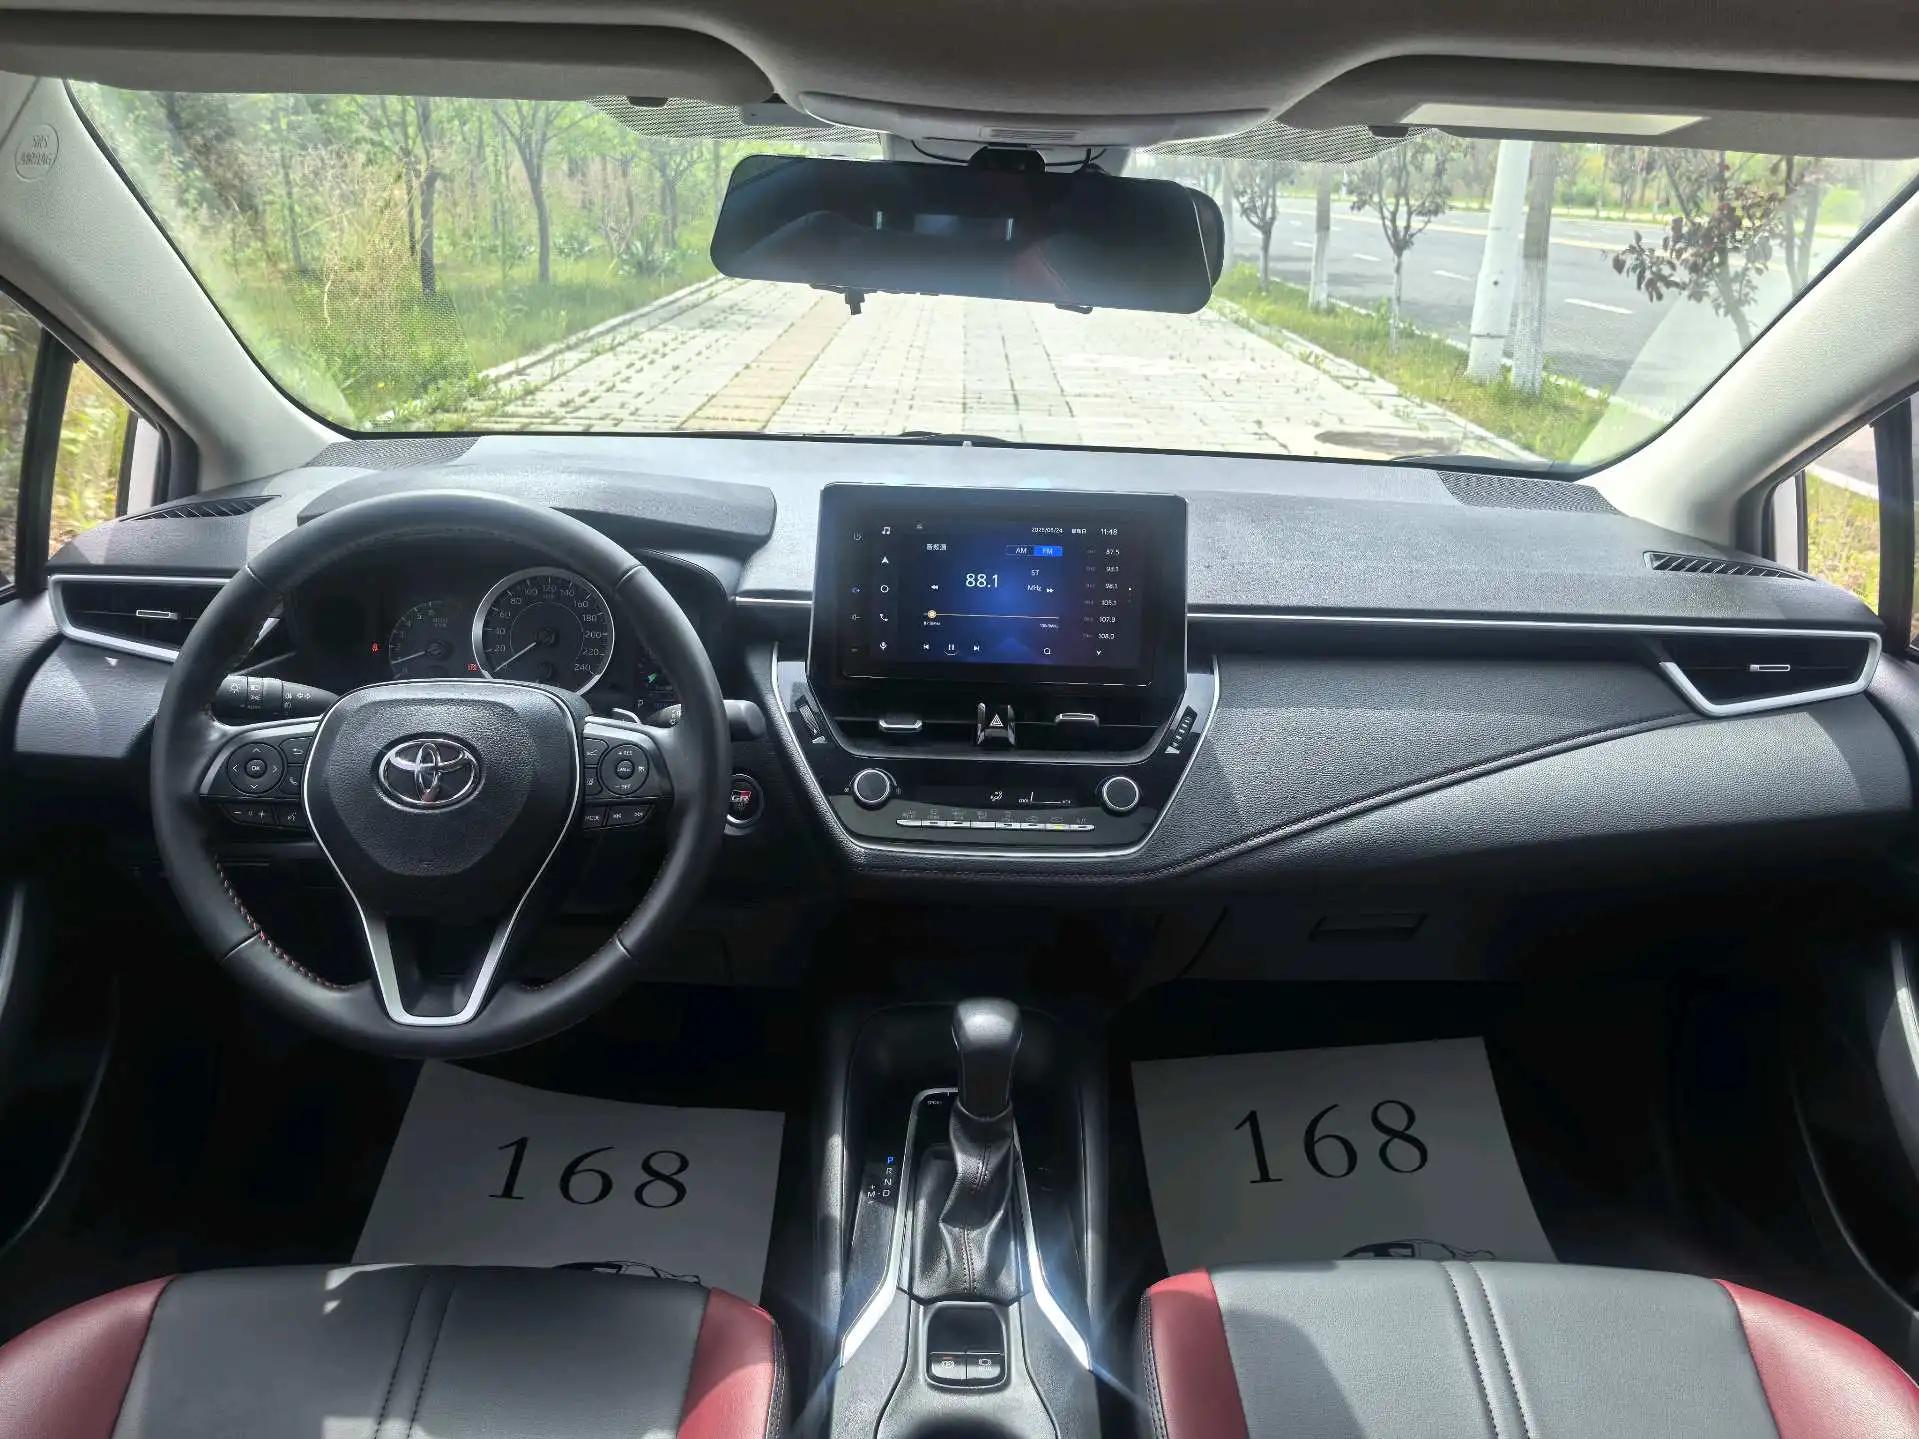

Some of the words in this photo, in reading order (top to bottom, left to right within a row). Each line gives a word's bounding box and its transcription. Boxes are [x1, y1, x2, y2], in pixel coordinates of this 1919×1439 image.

[965, 573, 998, 588] 88.1
[1027, 584, 1042, 592] MHz
[582, 614, 597, 622] 180
[583, 631, 601, 639] 200
[574, 663, 591, 671] 240
[1234, 1099, 1429, 1184] 168
[887, 1156, 894, 1164] P
[488, 1136, 690, 1208] 168
[886, 1167, 894, 1175] R
[884, 1178, 892, 1186] N
